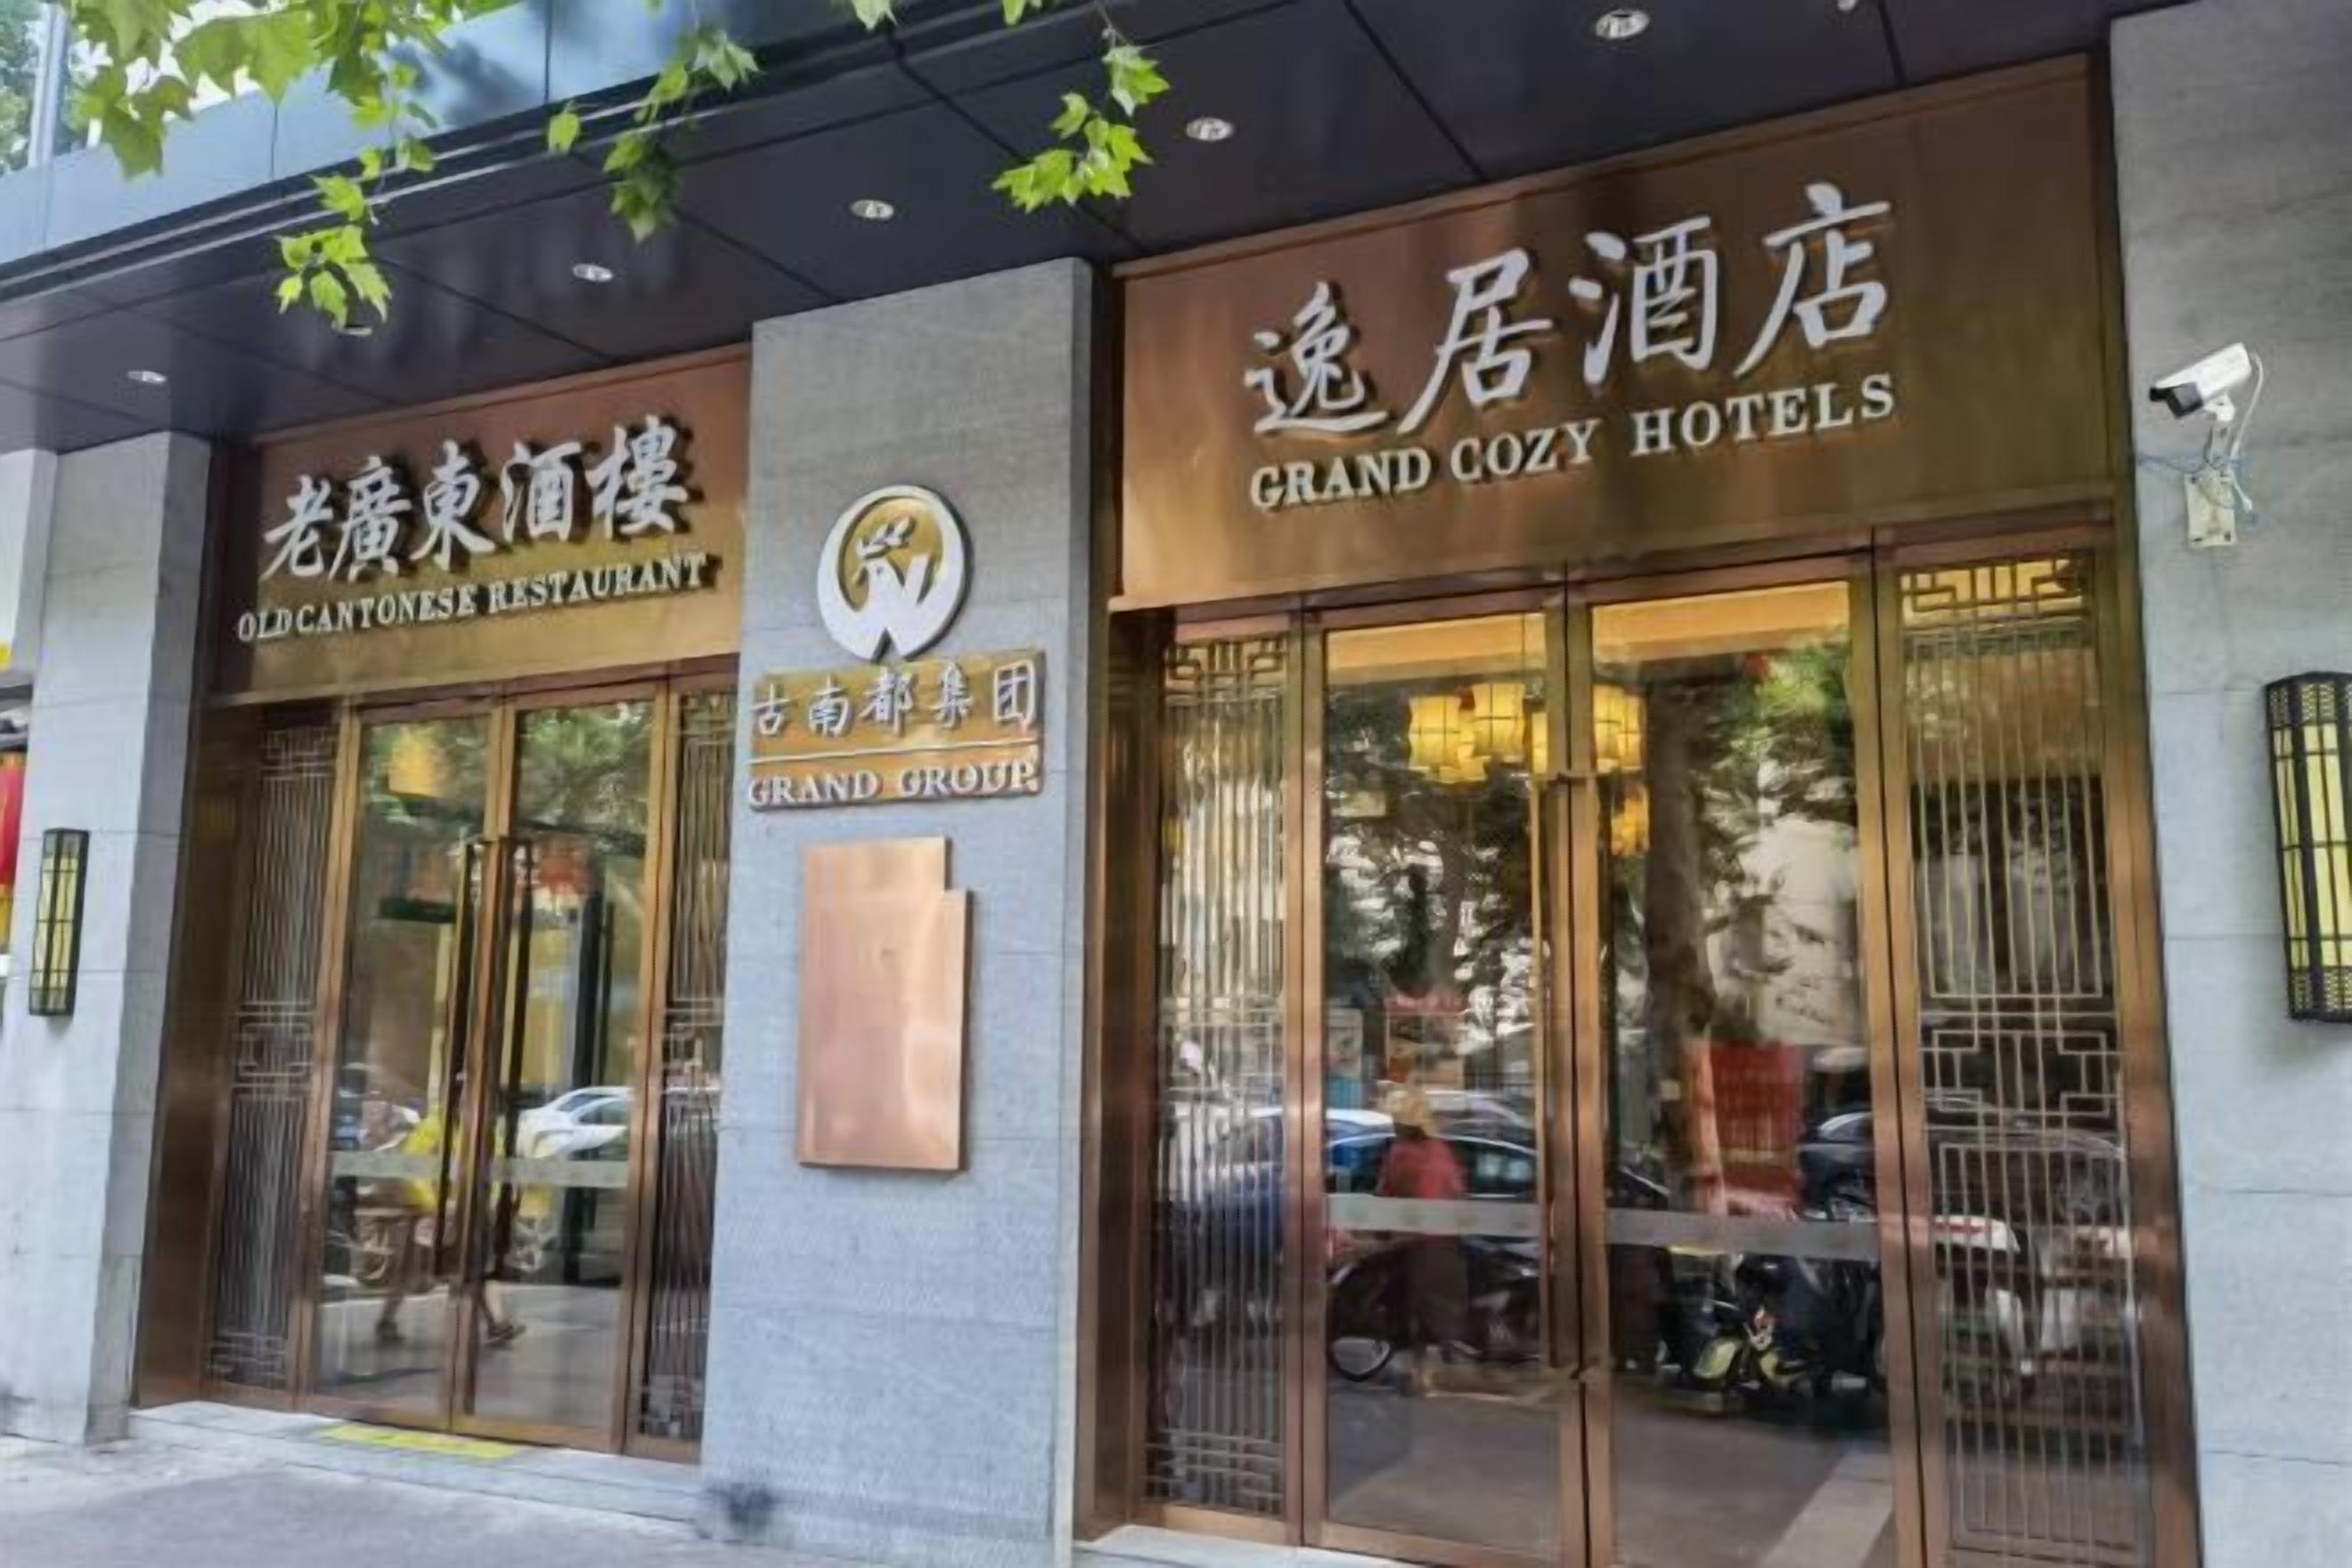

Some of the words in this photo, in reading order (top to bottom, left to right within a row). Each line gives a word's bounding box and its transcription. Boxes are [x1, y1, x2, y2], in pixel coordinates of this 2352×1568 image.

[1244, 182, 1891, 435] 逸居酒店
[1250, 445, 1432, 510] GRAND
[1450, 418, 1602, 483] COZY
[1631, 372, 1895, 456] HOTELS
[488, 551, 710, 613] RESTAURANT
[749, 658, 1036, 739] 古南都集团
[748, 769, 879, 805] GRAND
[898, 757, 1036, 796] GROUP
